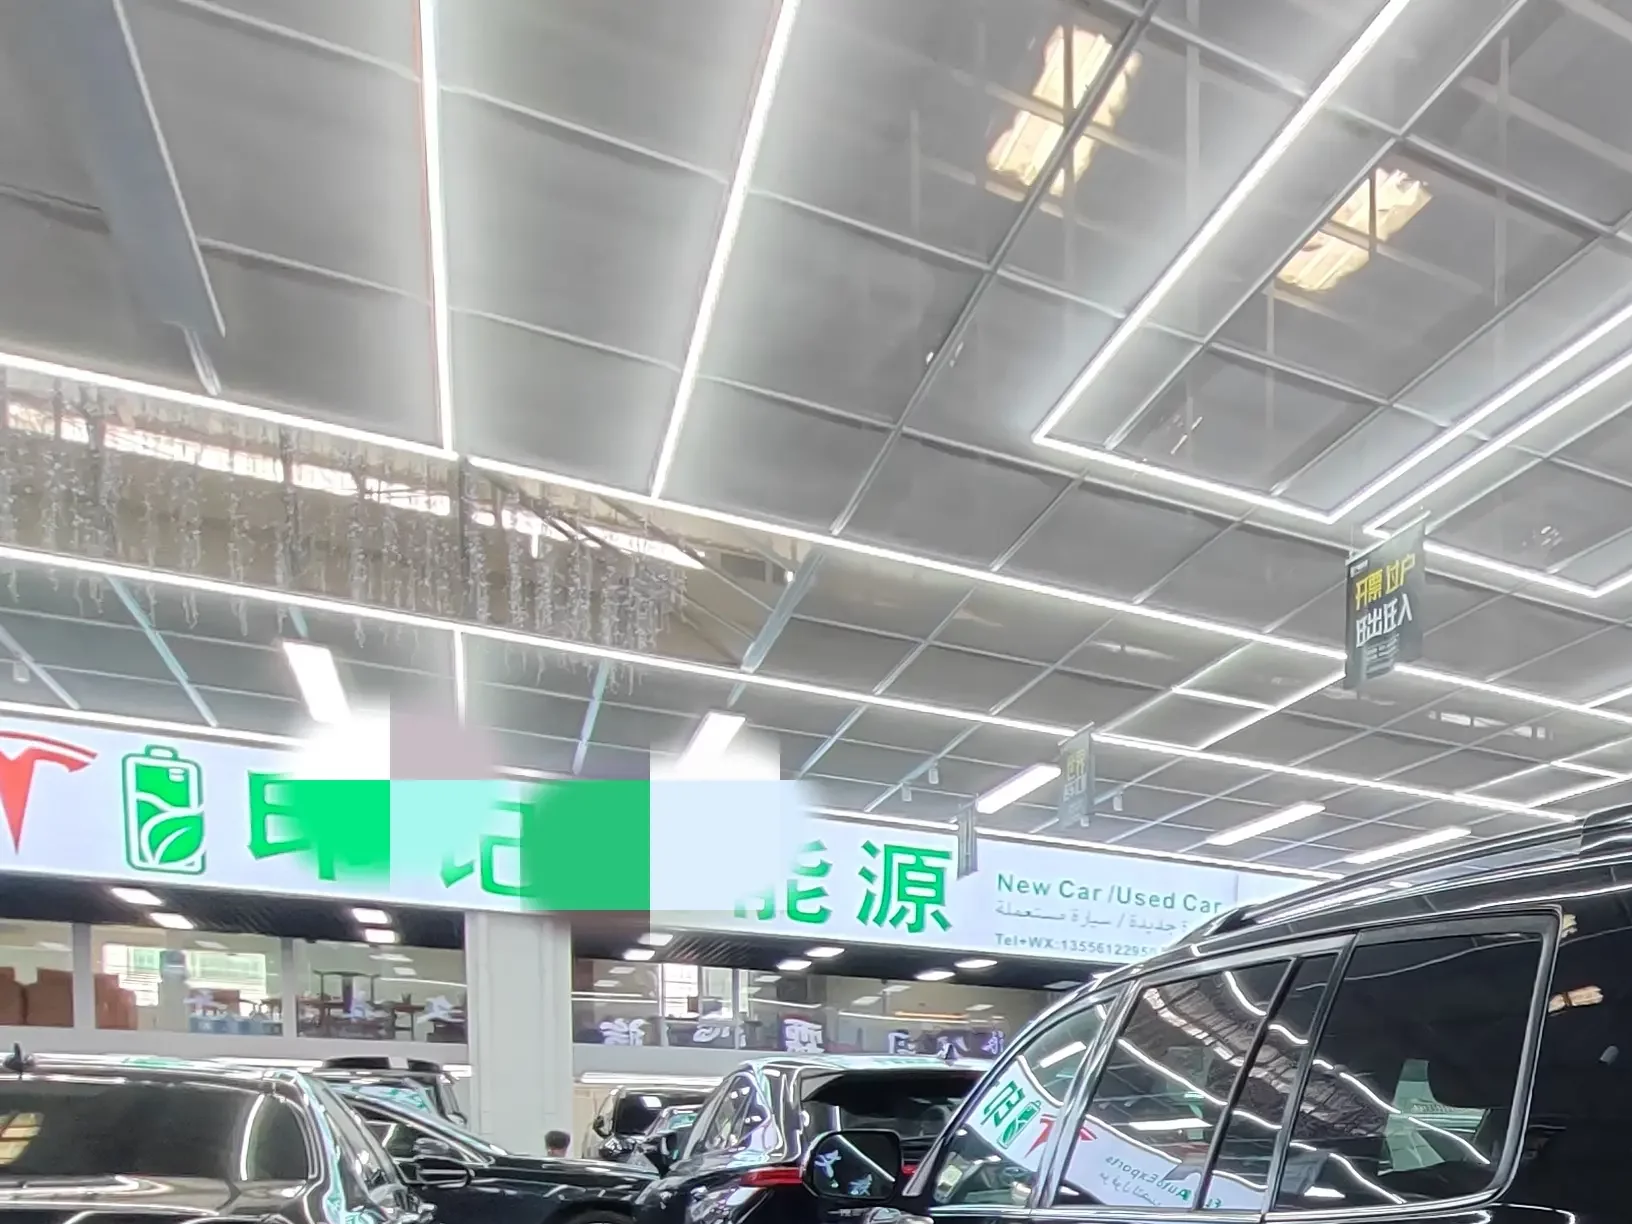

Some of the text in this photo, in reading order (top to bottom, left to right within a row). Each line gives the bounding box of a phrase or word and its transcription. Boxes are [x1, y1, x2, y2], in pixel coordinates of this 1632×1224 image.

[997, 873, 1051, 896] New
[1059, 880, 1102, 902] Car
[1183, 893, 1222, 914] Car
